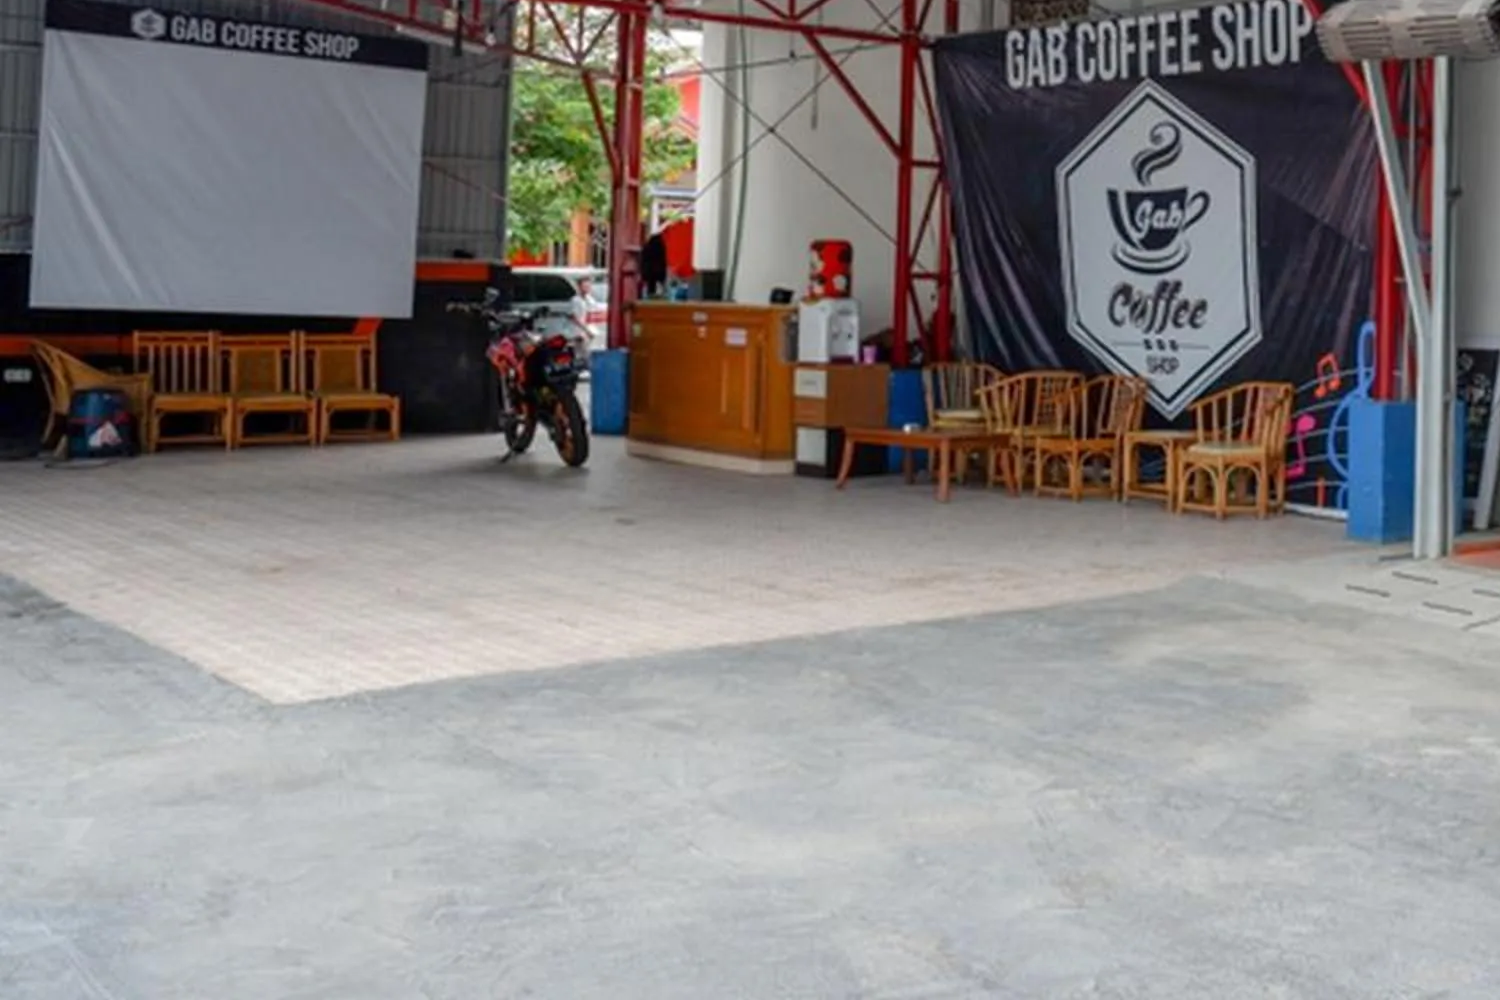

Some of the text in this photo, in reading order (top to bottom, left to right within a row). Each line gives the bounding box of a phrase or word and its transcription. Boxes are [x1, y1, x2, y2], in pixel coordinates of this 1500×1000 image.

[171, 16, 360, 60] GAB COFFEE SHOP
[1006, 20, 1069, 89] GAB
[1075, 9, 1202, 83] COFFEE
[1135, 201, 1184, 240] Gab
[1107, 279, 1208, 334] Coffee
